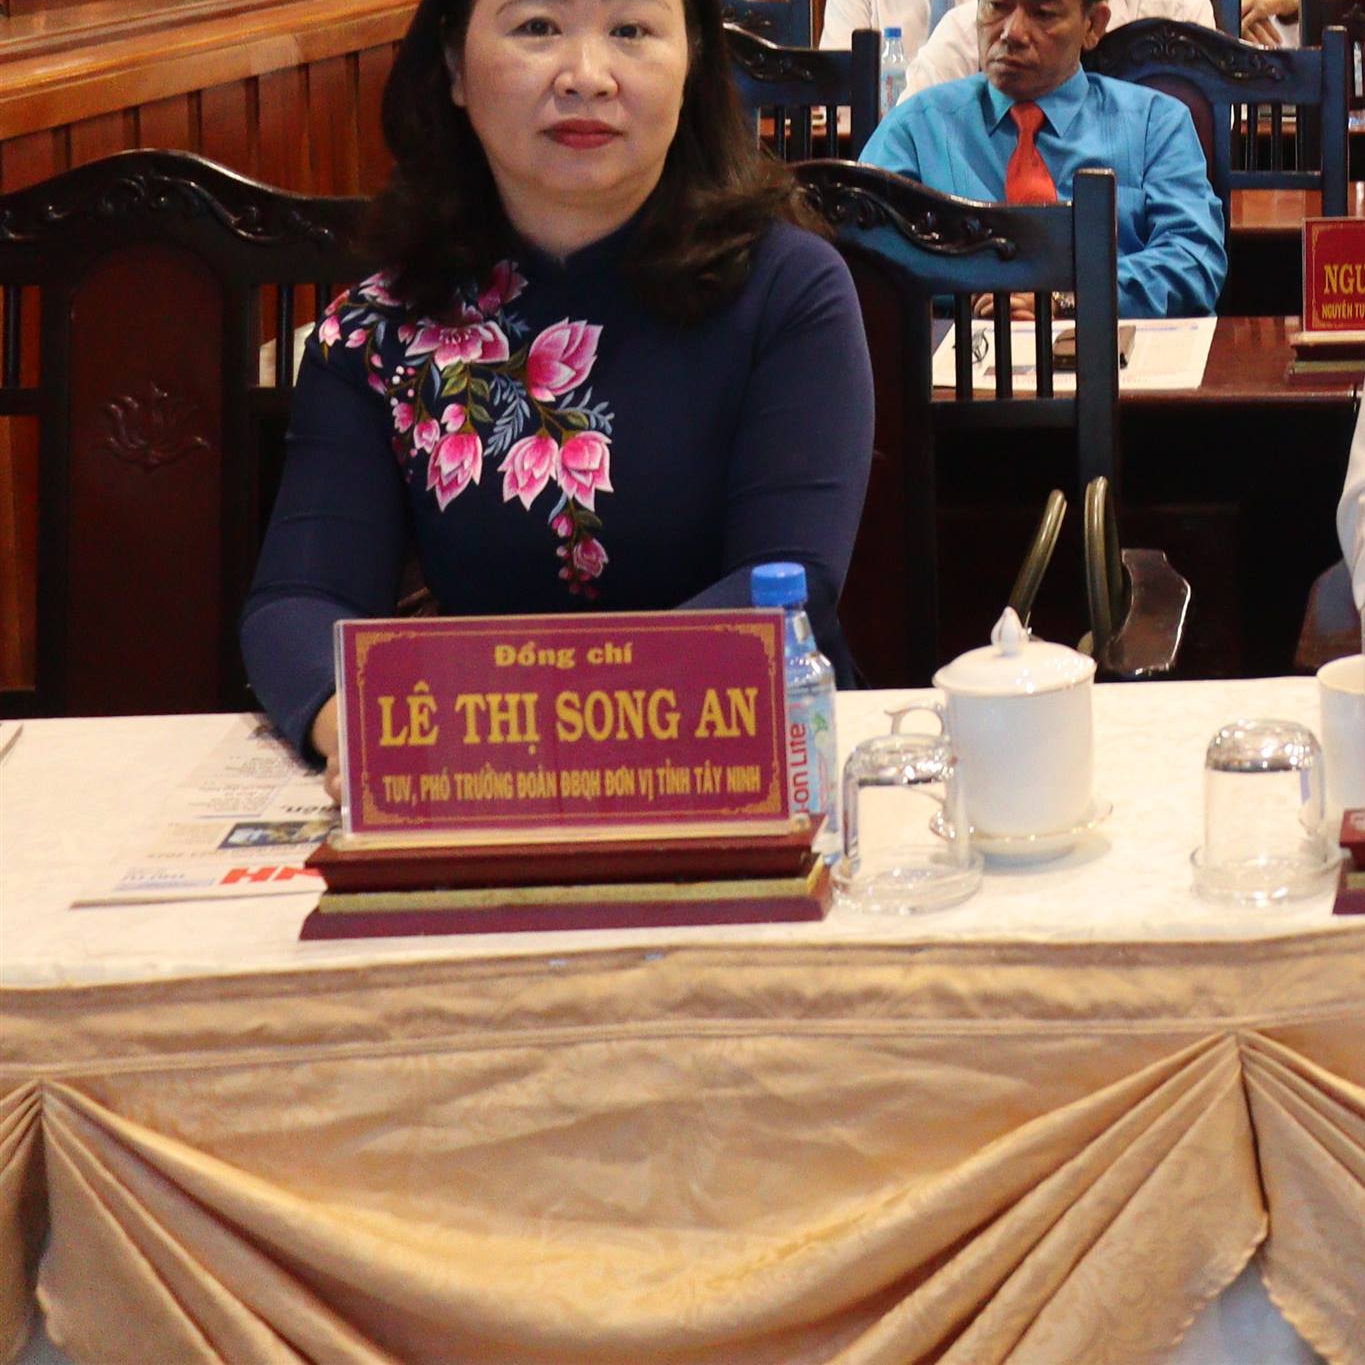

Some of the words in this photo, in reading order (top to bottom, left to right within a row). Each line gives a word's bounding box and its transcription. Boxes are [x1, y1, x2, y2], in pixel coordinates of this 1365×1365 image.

[1321, 299, 1353, 320] NGUYÊN
[495, 641, 575, 670] Đồng
[587, 642, 633, 664] chí
[377, 681, 438, 747] LÊ
[456, 691, 540, 755] THỊ
[555, 687, 680, 742] SONG
[695, 686, 759, 739] AN
[383, 774, 418, 807] TUV,
[421, 767, 450, 801] PHÓ
[454, 762, 514, 801] TRƯỞNG
[517, 765, 558, 799] ĐOÀN
[605, 764, 635, 797] ĐƠN
[639, 766, 654, 801] VỊ
[656, 758, 690, 796] TỈNH
[694, 759, 722, 795] TÂY
[726, 765, 762, 794] NINH
